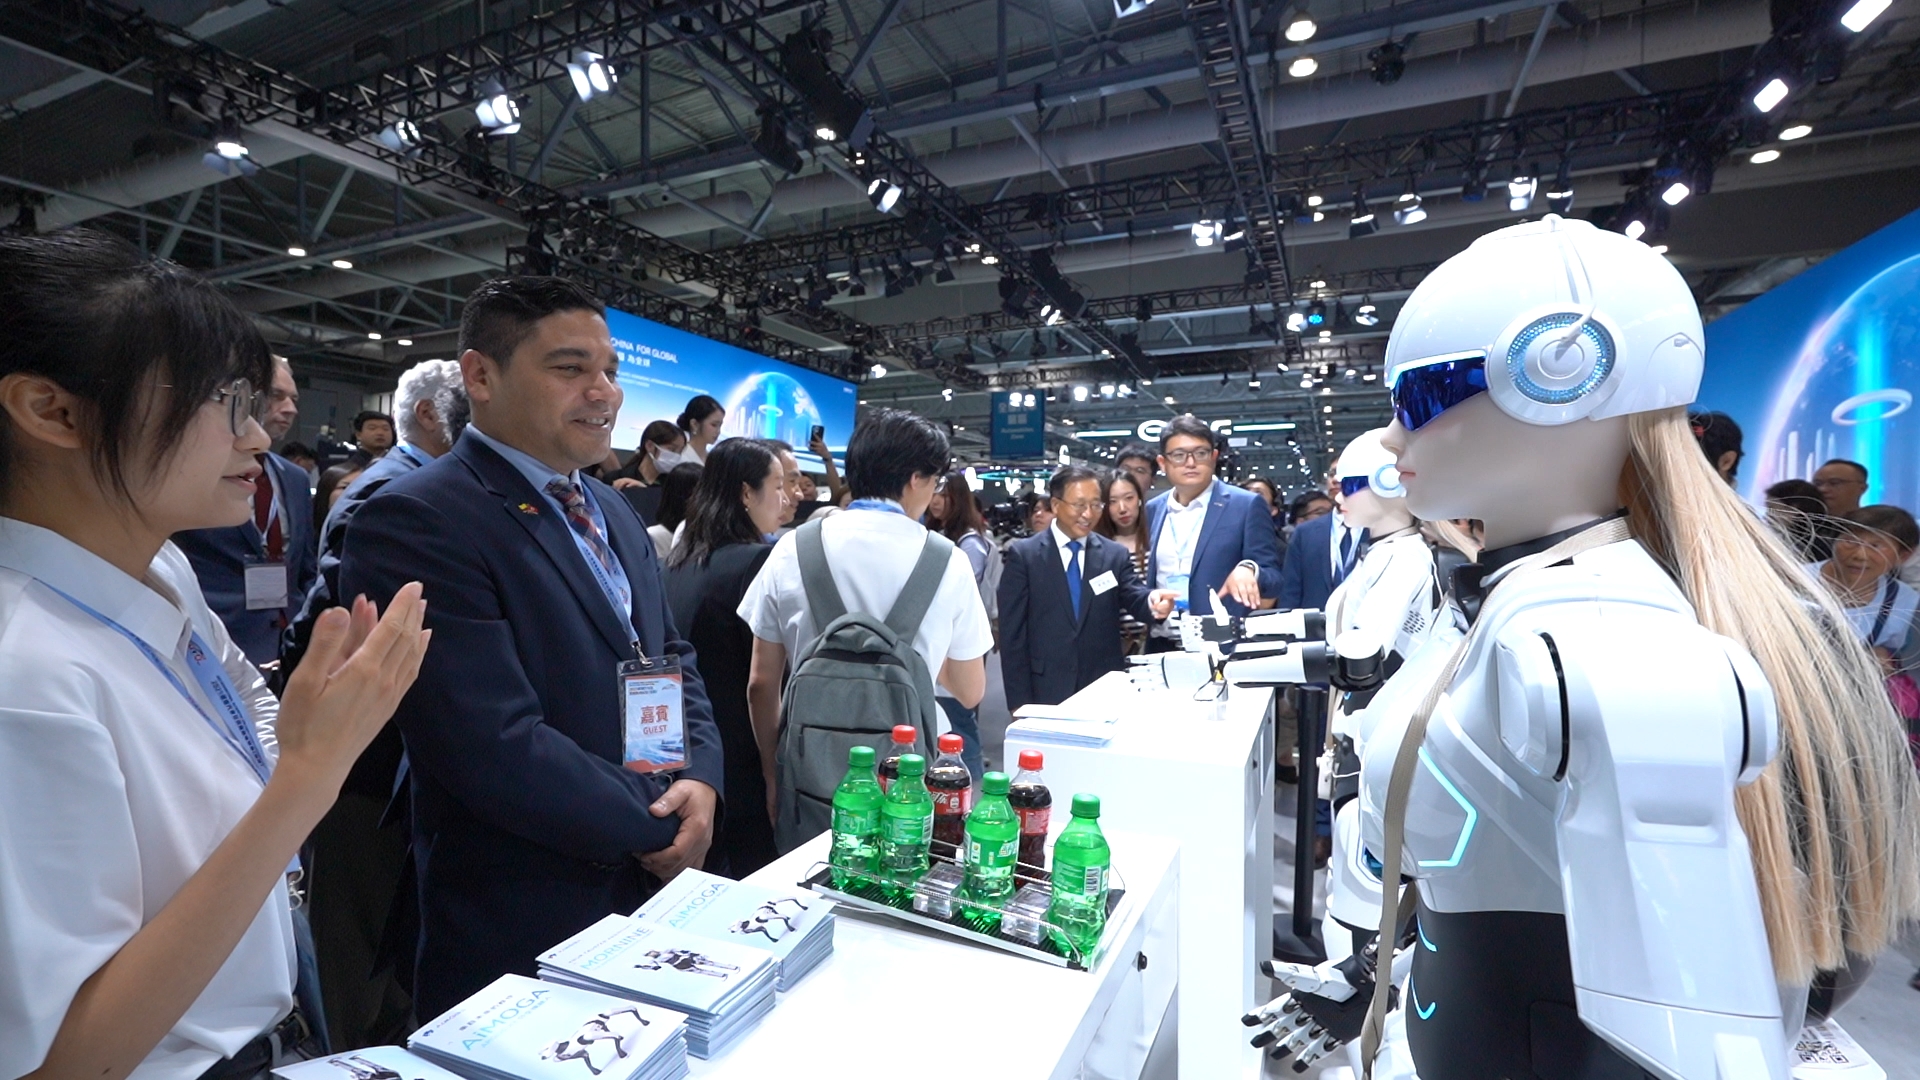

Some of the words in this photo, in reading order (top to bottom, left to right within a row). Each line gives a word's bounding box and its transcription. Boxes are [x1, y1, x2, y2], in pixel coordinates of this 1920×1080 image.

[636, 344, 651, 356] FOR
[652, 349, 678, 364] GLOBAL
[641, 704, 668, 724] 嘉賓
[643, 725, 667, 735] GUEST
[580, 926, 650, 970] MORNINE
